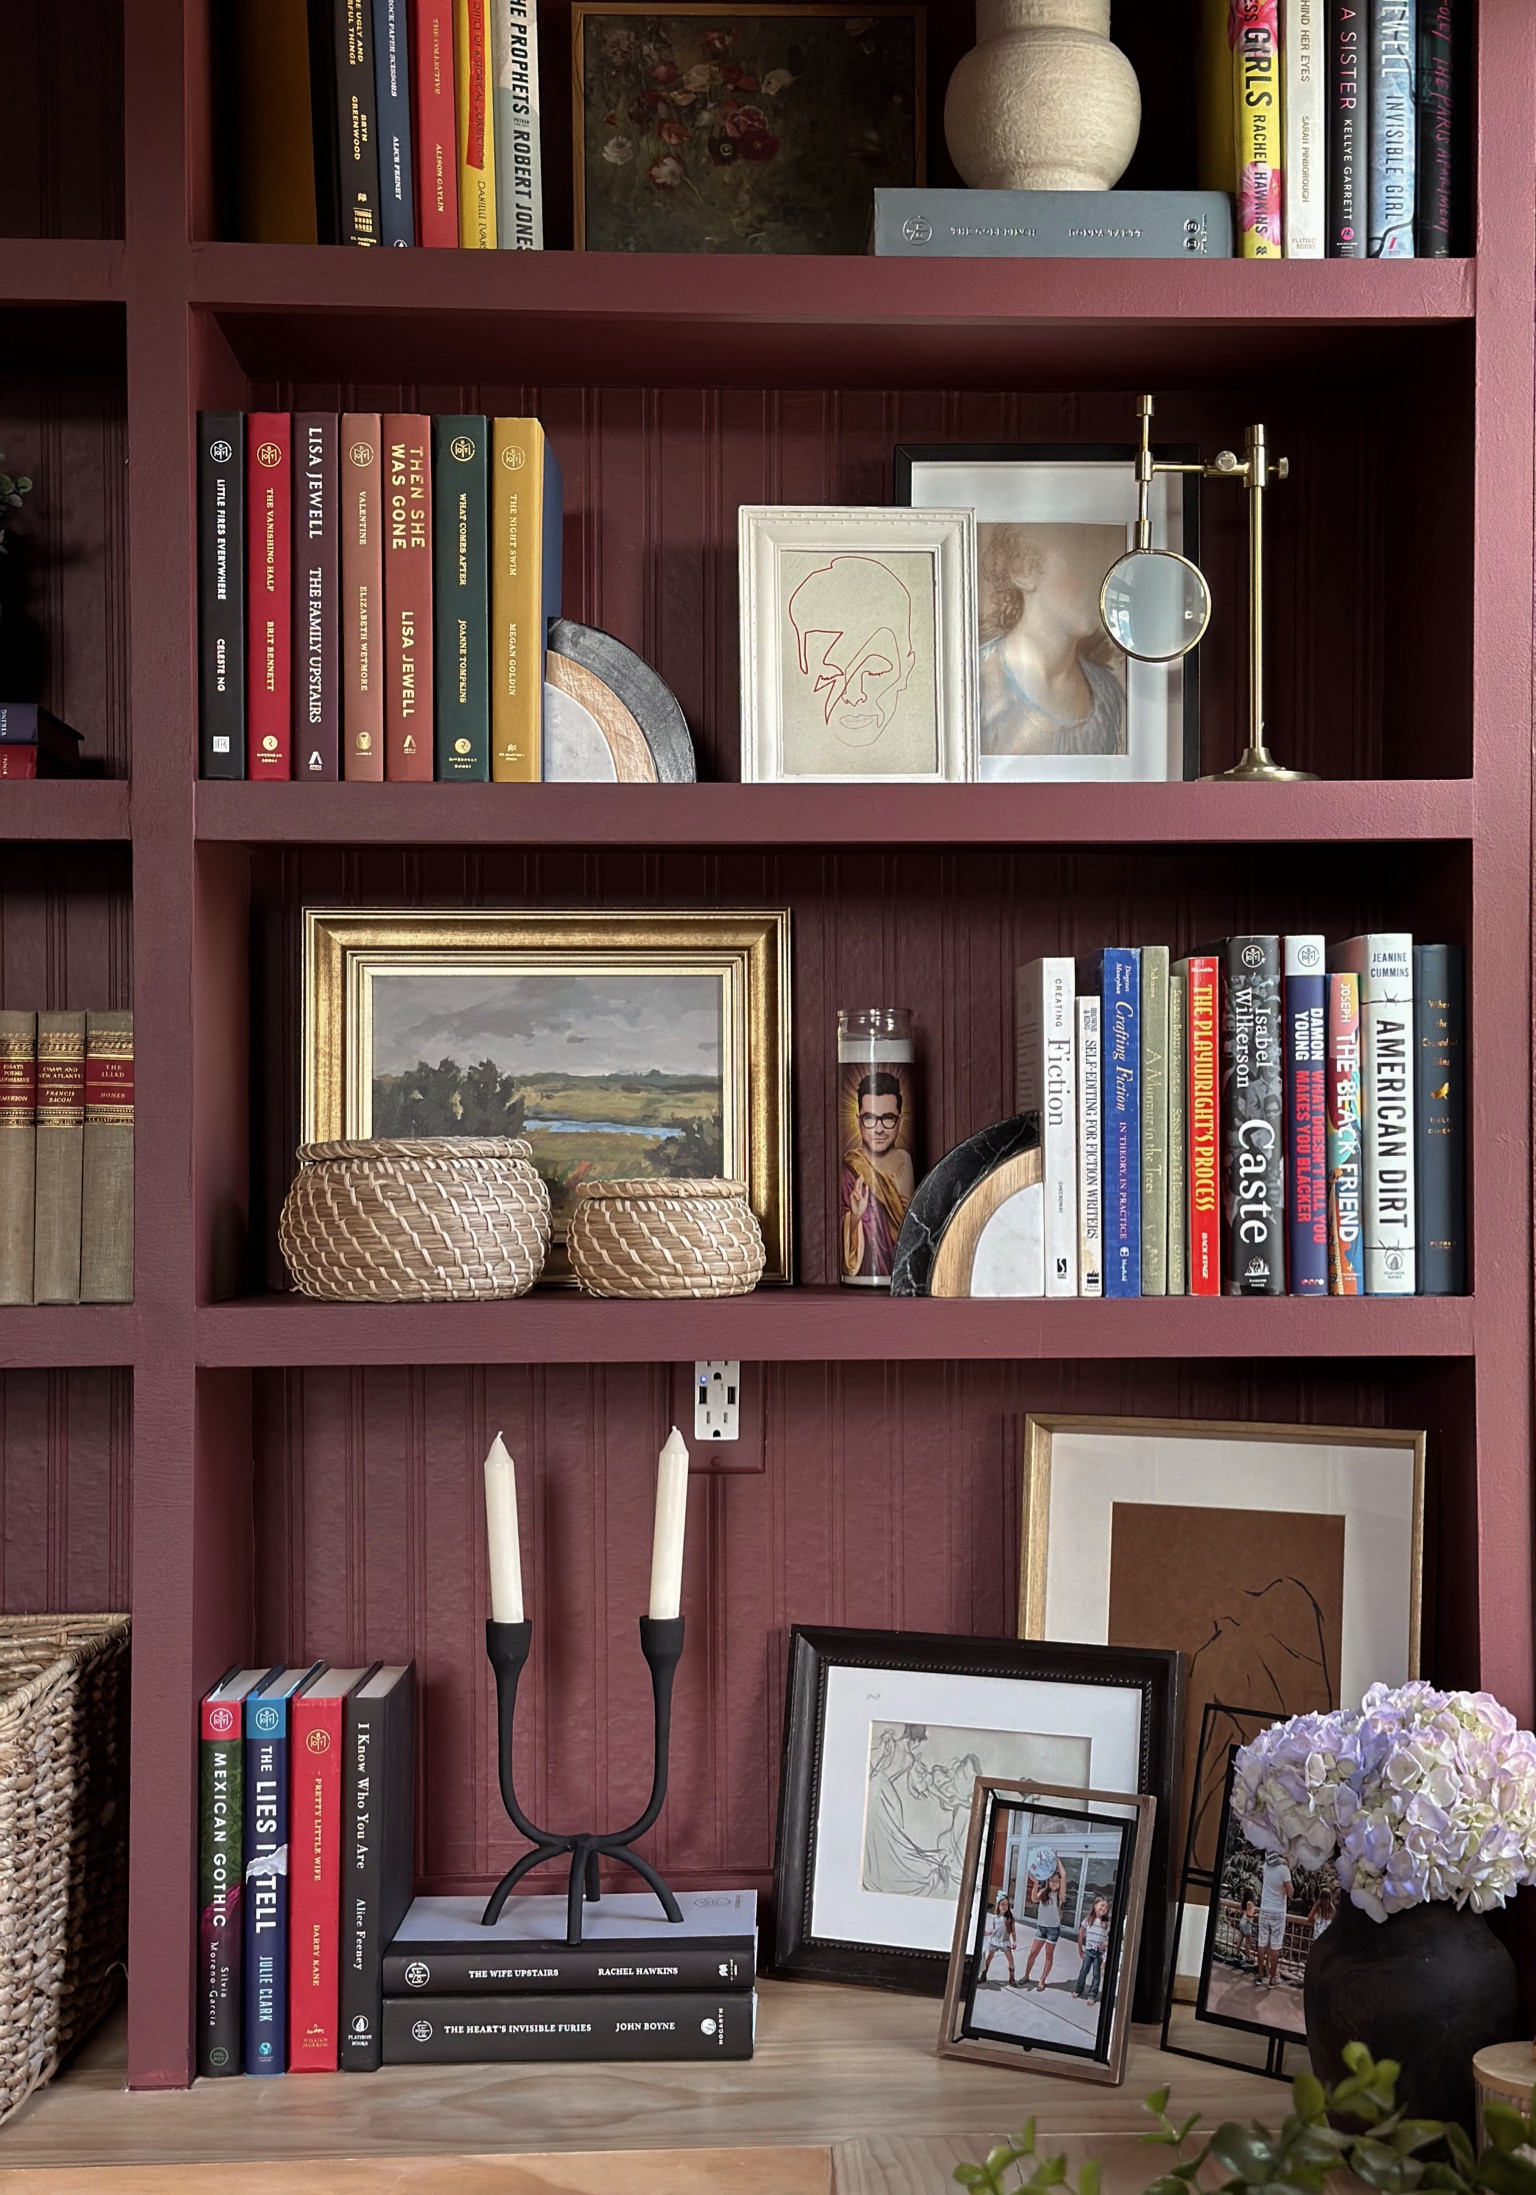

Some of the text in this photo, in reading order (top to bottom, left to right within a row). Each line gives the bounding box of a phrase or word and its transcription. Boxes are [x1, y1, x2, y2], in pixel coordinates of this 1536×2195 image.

[356, 39, 364, 62] AND
[388, 23, 396, 52] PAPER
[511, 23, 529, 115] PROPHETS
[1245, 27, 1272, 107] GIRLS
[1300, 30, 1310, 82] HER EYES
[1340, 8, 1356, 110] A SISTER
[474, 50, 484, 102] HISTORICAL
[352, 96, 360, 160] GREENWOOD
[1302, 116, 1310, 203] SARAH PINBOROUGH
[1386, 96, 1404, 220] INVISIBLE GIRL
[1428, 58, 1451, 234] THE PARIS APARTMENT
[514, 130, 532, 198] ROBERT
[1253, 115, 1268, 234] RACHEL HAWKINS
[1344, 120, 1352, 220] KELLYE GARRETT
[477, 181, 486, 220] DANIELLE
[306, 427, 323, 539] LISA JEWELL
[391, 443, 406, 549] WAS GONE
[411, 447, 425, 548] THEN SHE
[217, 480, 227, 600] LITTLE FIRES EVERYWHERE
[266, 488, 275, 592] THE VANISHING HALF
[459, 494, 467, 585] WHAT COMES AFTER
[509, 516, 517, 547] NIGHT
[509, 550, 517, 576] SWIM
[217, 638, 226, 692] CELESTE NG
[266, 621, 275, 692] BRIT BENNETT
[309, 567, 322, 724] THE FAMILY UPSTAIRS
[359, 586, 368, 691] ELIZABETH WETMORE
[402, 611, 415, 717] LISA JEWELL
[458, 620, 467, 703] JOANNE TOMPKINS
[509, 623, 517, 656] MEGAN
[1370, 968, 1409, 977] CUMMINS
[1372, 953, 1407, 962] JEANINE
[1193, 984, 1212, 1016] THE
[1311, 1007, 1324, 1061] DAMON
[1340, 983, 1351, 1022] JOSEPH
[1113, 1001, 1133, 1111] Crafting Fiction
[1236, 987, 1252, 1088] Wilkerson
[1255, 1008, 1273, 1068] Isabel
[1295, 1011, 1309, 1061] YOUNG
[1047, 1038, 1071, 1126] Fiction
[1193, 1020, 1214, 1142] PLAYWRIGHT'S
[1085, 1040, 1098, 1239] SELF-EDITING FOR FICTION WRITERS
[1146, 1048, 1161, 1194] A the Trees
[1295, 1070, 1311, 1223] MAKES YOU BLACKER
[1336, 1033, 1358, 1242] THE BLACK FRIEND
[1376, 1019, 1408, 1228] AMERICAN DIRT
[1120, 1122, 1128, 1240] IN THEORY, IN PRACTICE
[1195, 1147, 1215, 1212] PROCESS
[1238, 1119, 1275, 1244] Caste
[1311, 1070, 1326, 1243] WHAT DOESN'T KILL YOU
[261, 1746, 272, 1771] THE
[357, 1734, 370, 1773] Know
[256, 1781, 277, 1833] LIES
[314, 1778, 322, 1817] PRETTY
[356, 1778, 370, 1808] Who
[356, 1814, 369, 1839] You
[213, 1753, 226, 1927] MEXICAN GOTHIC
[314, 1820, 322, 1853] LITTLE
[356, 1844, 369, 1868] Are
[255, 1876, 277, 1933] TELL
[353, 1899, 366, 1970] Alice Feeney
[209, 1942, 218, 2026] Moreno-Garcia
[221, 1967, 229, 1998] Silvia
[259, 1956, 273, 2022] JULIE CLARK
[469, 1968, 559, 1979] THE WIFE UPSTAIRS
[598, 1966, 678, 1976] RACHEL HAWKINS
[444, 2022, 592, 2034] THE HEART'S INVISIBLE FURIES
[615, 2021, 675, 2031] JOHN BOYNE
